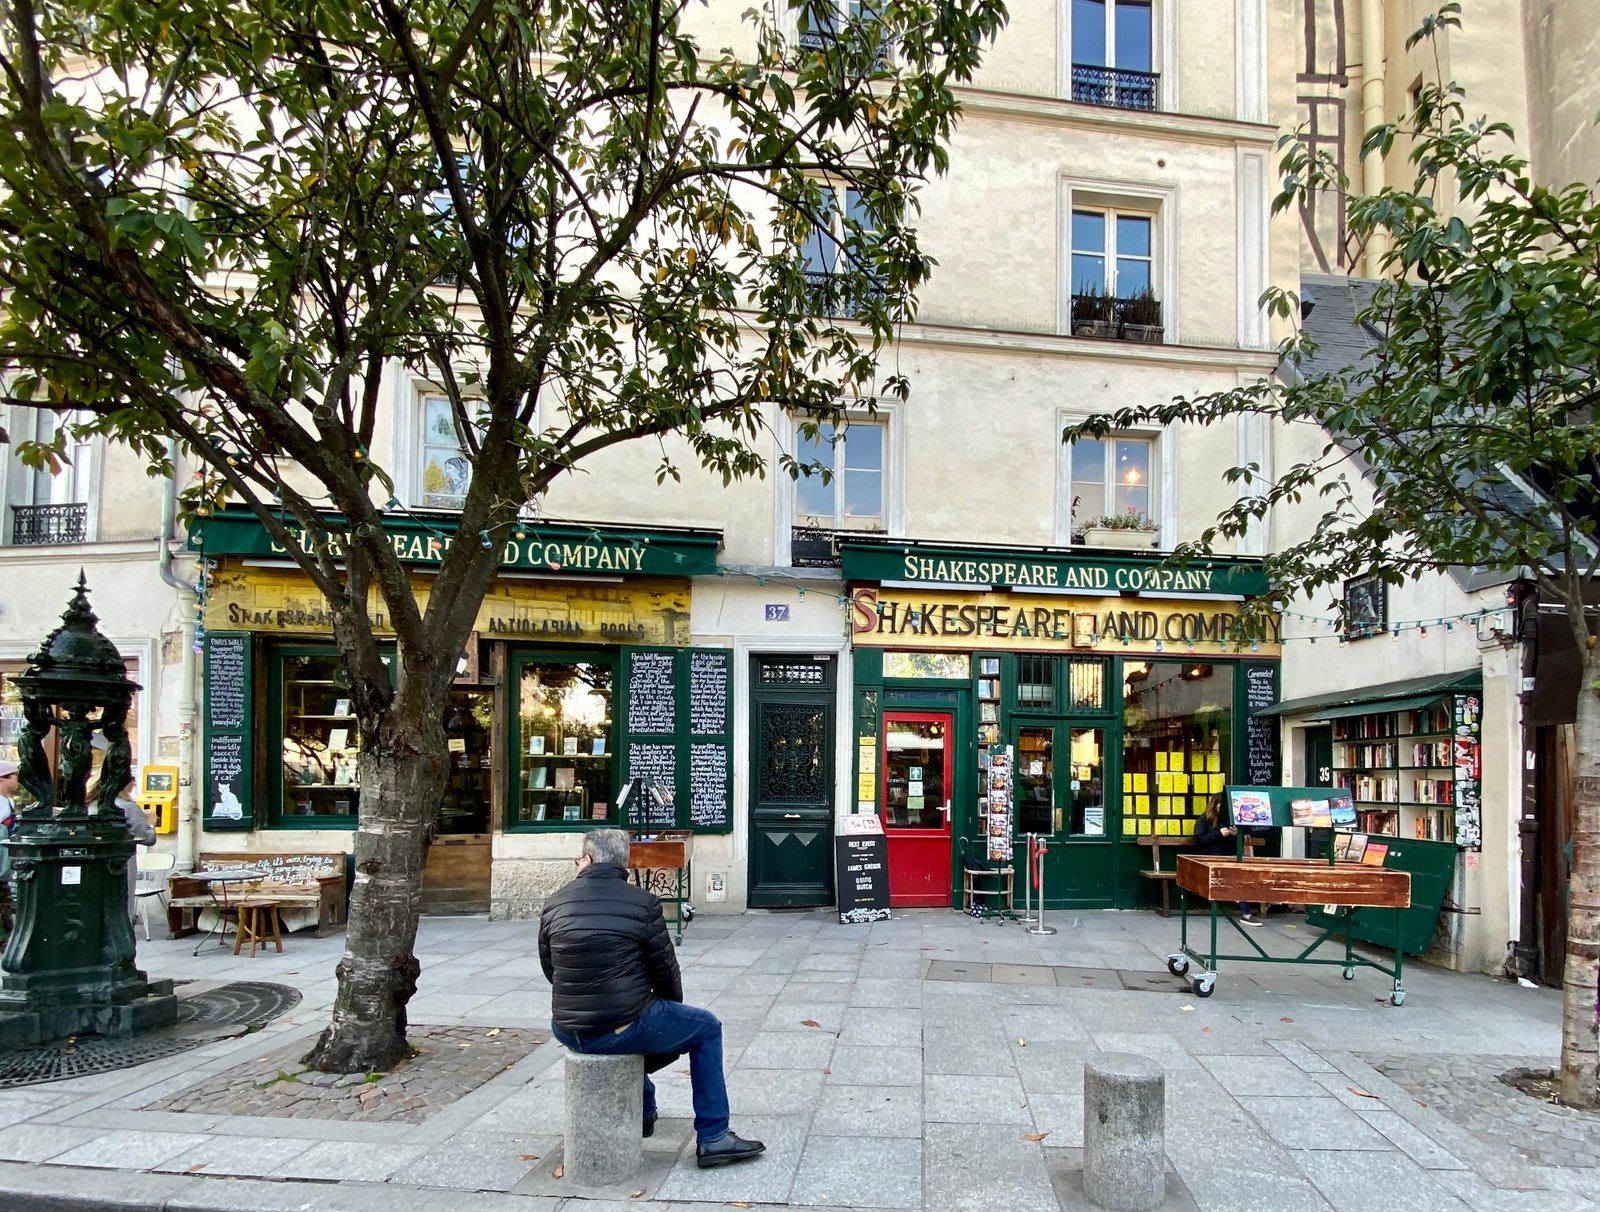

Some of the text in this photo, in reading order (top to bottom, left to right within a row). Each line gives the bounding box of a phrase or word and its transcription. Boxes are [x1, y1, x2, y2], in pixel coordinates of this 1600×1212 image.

[528, 541, 646, 570] COMPANY
[904, 556, 1213, 591] SHAKESPEARE AND COMPANY
[768, 606, 786, 620] 37
[854, 590, 1283, 644] SHAKESPEARE AND COMPNY
[211, 638, 243, 646] PARIS WALL
[1320, 767, 1330, 782] 39
[273, 857, 284, 866] it's
[286, 872, 312, 880] bench
